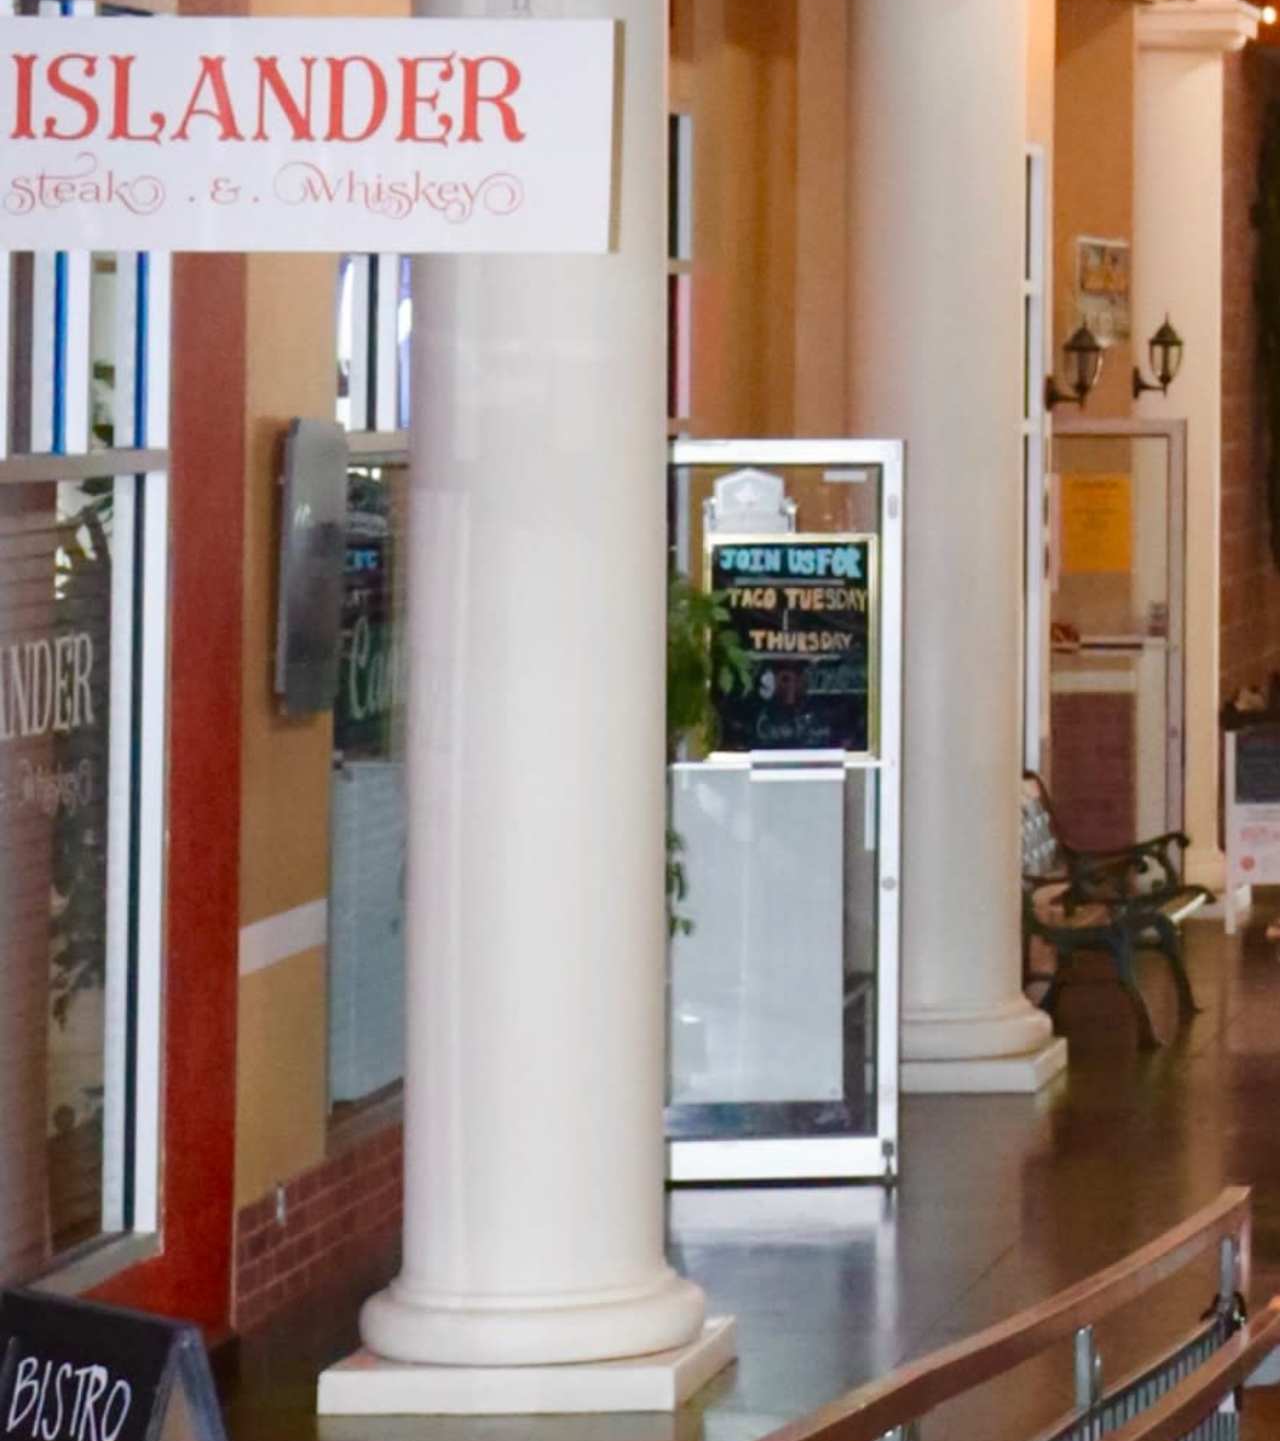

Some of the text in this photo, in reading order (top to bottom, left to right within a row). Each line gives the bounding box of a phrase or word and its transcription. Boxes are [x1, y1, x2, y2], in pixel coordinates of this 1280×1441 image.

[9, 51, 526, 147] ISLANDER
[719, 547, 782, 572] JOIN
[726, 587, 869, 612] TACO TUESDAY
